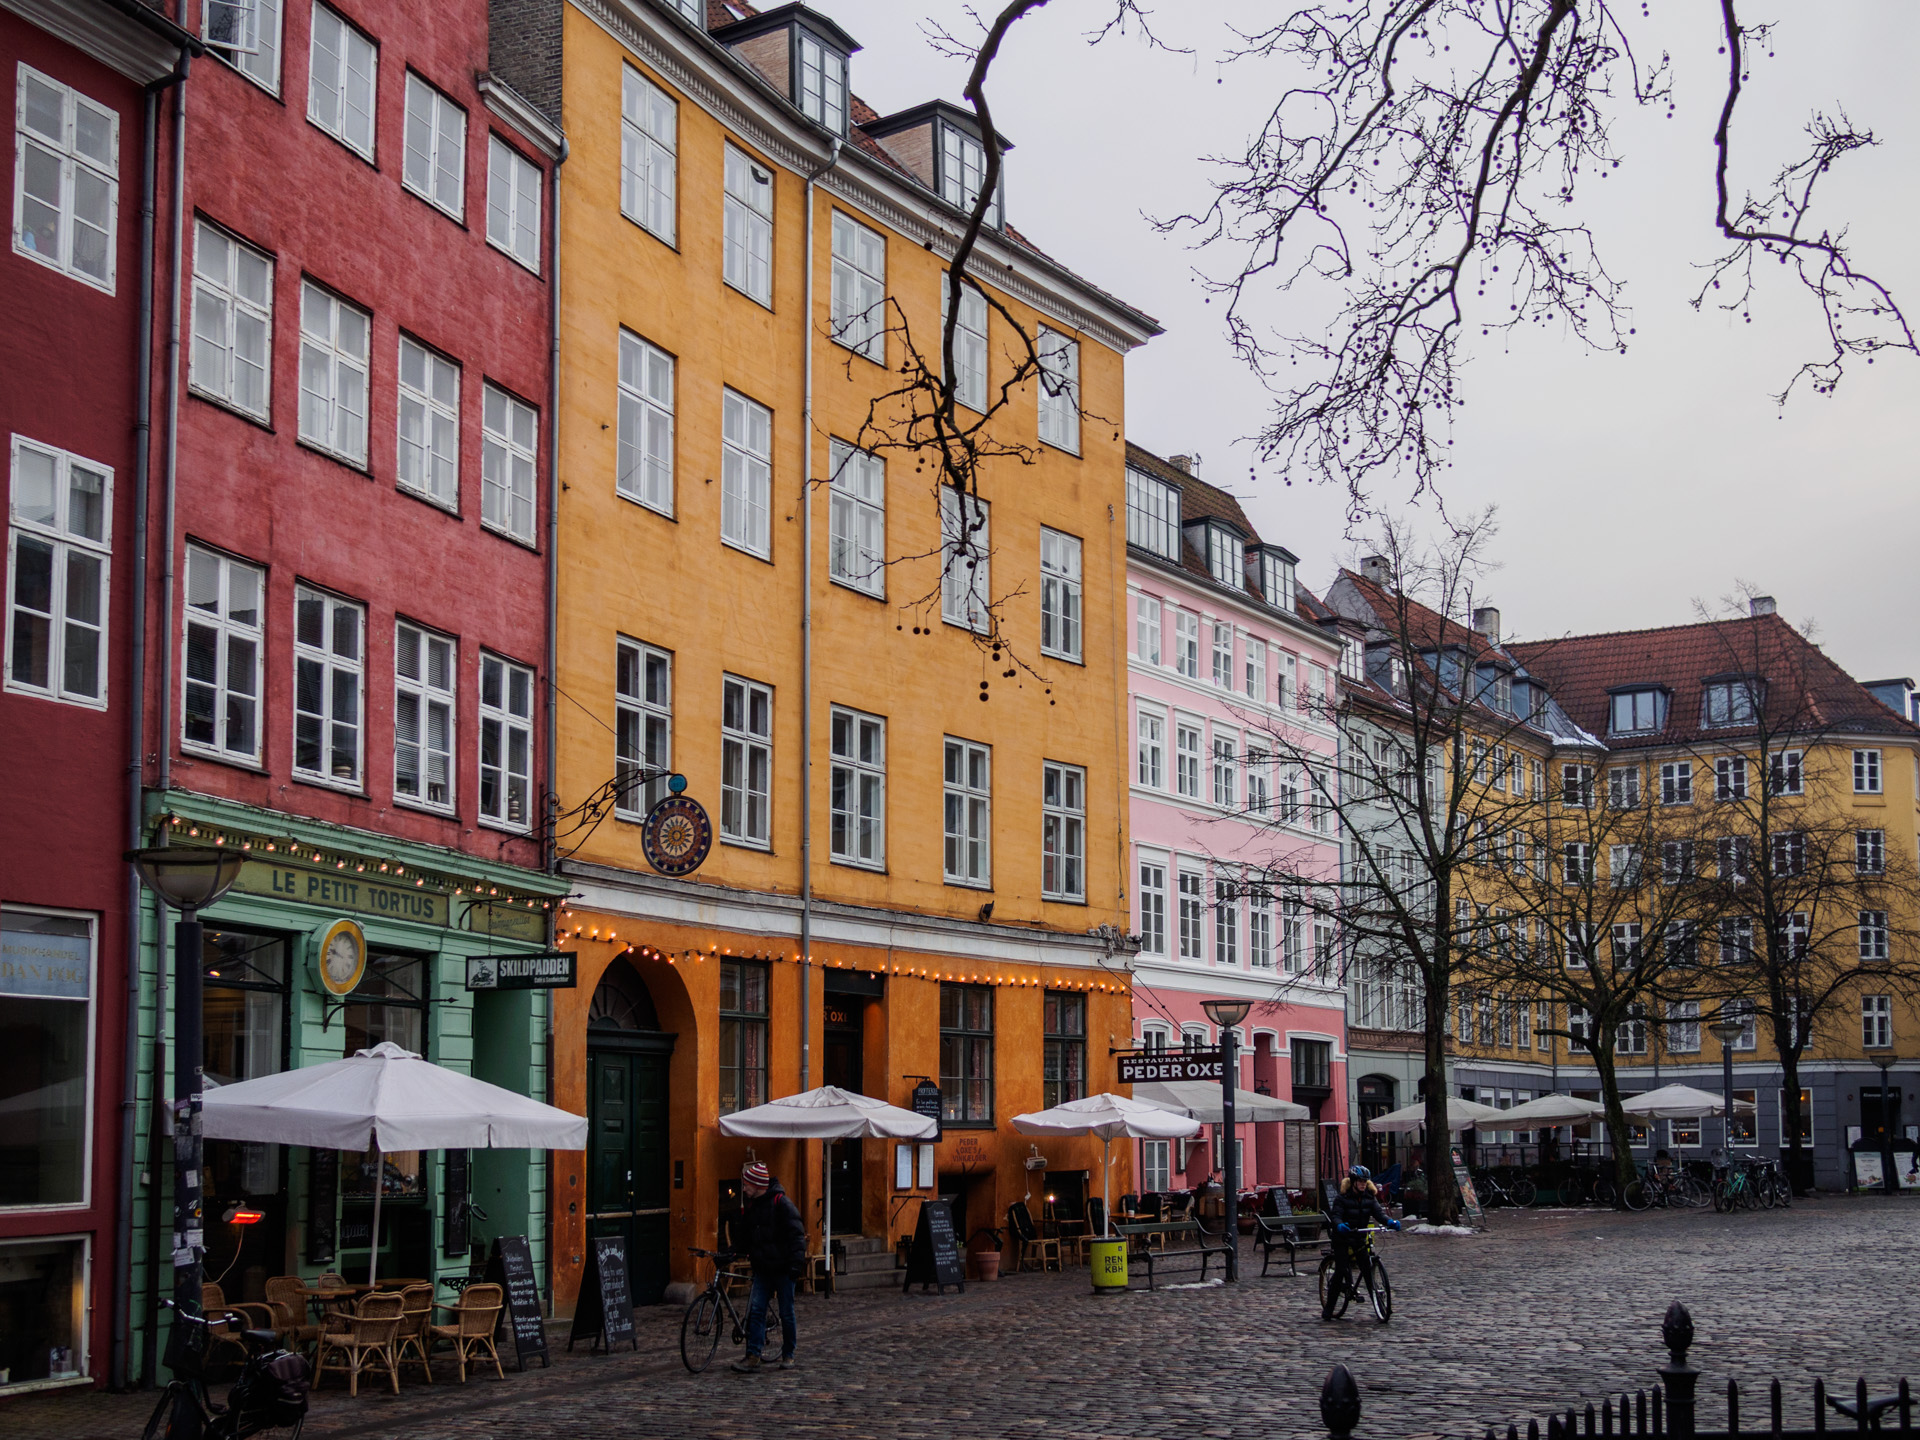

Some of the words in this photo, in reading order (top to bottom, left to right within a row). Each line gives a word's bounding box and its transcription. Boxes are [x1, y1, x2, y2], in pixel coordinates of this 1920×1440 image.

[272, 869, 296, 894] LE
[308, 876, 359, 905] PETIT
[368, 887, 434, 919] TORTUS
[2, 943, 81, 961] MUSIKHANDEL
[1, 961, 42, 979] DAN
[500, 958, 570, 977] SKILDPADDEN
[1123, 1057, 1193, 1065] RESTAURANT
[1123, 1064, 1182, 1079] PEDER
[1186, 1062, 1224, 1077] OXE
[960, 1138, 978, 1146] PEDER
[952, 1153, 987, 1162] VINKÆLDER
[1104, 1255, 1123, 1264] REN
[1105, 1265, 1124, 1274] KBH
